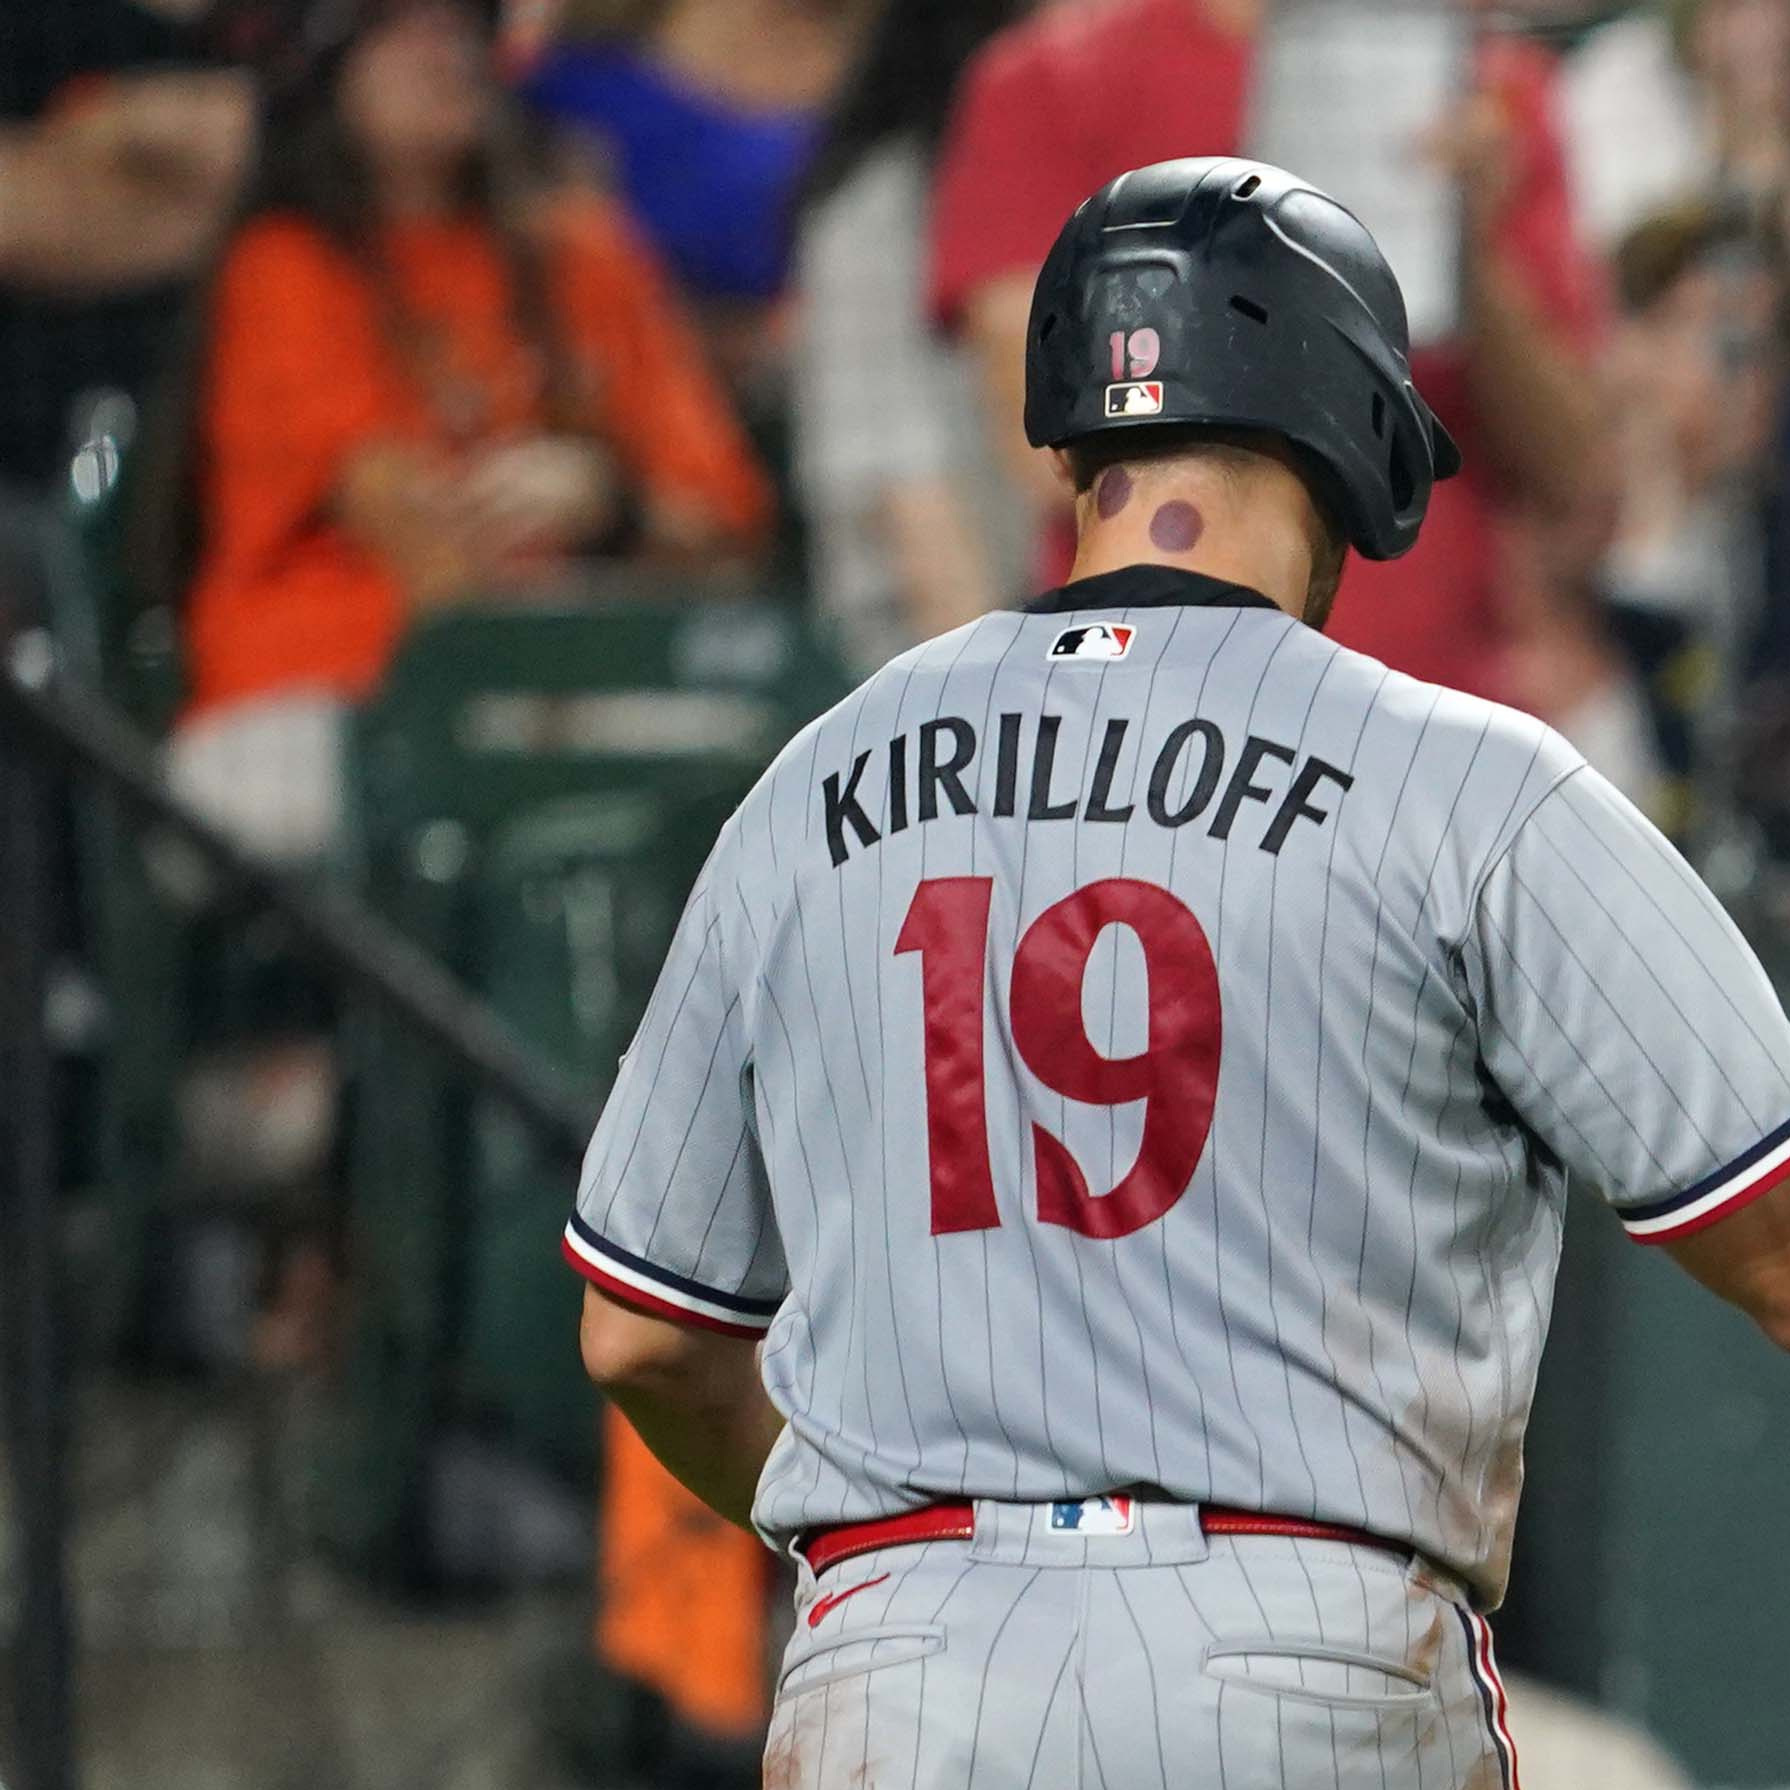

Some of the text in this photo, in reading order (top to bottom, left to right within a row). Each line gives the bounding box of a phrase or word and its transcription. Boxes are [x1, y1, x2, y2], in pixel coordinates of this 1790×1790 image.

[1109, 328, 1160, 380] 19
[823, 714, 1353, 867] KIRILLOFF
[893, 877, 1221, 1238] 19
